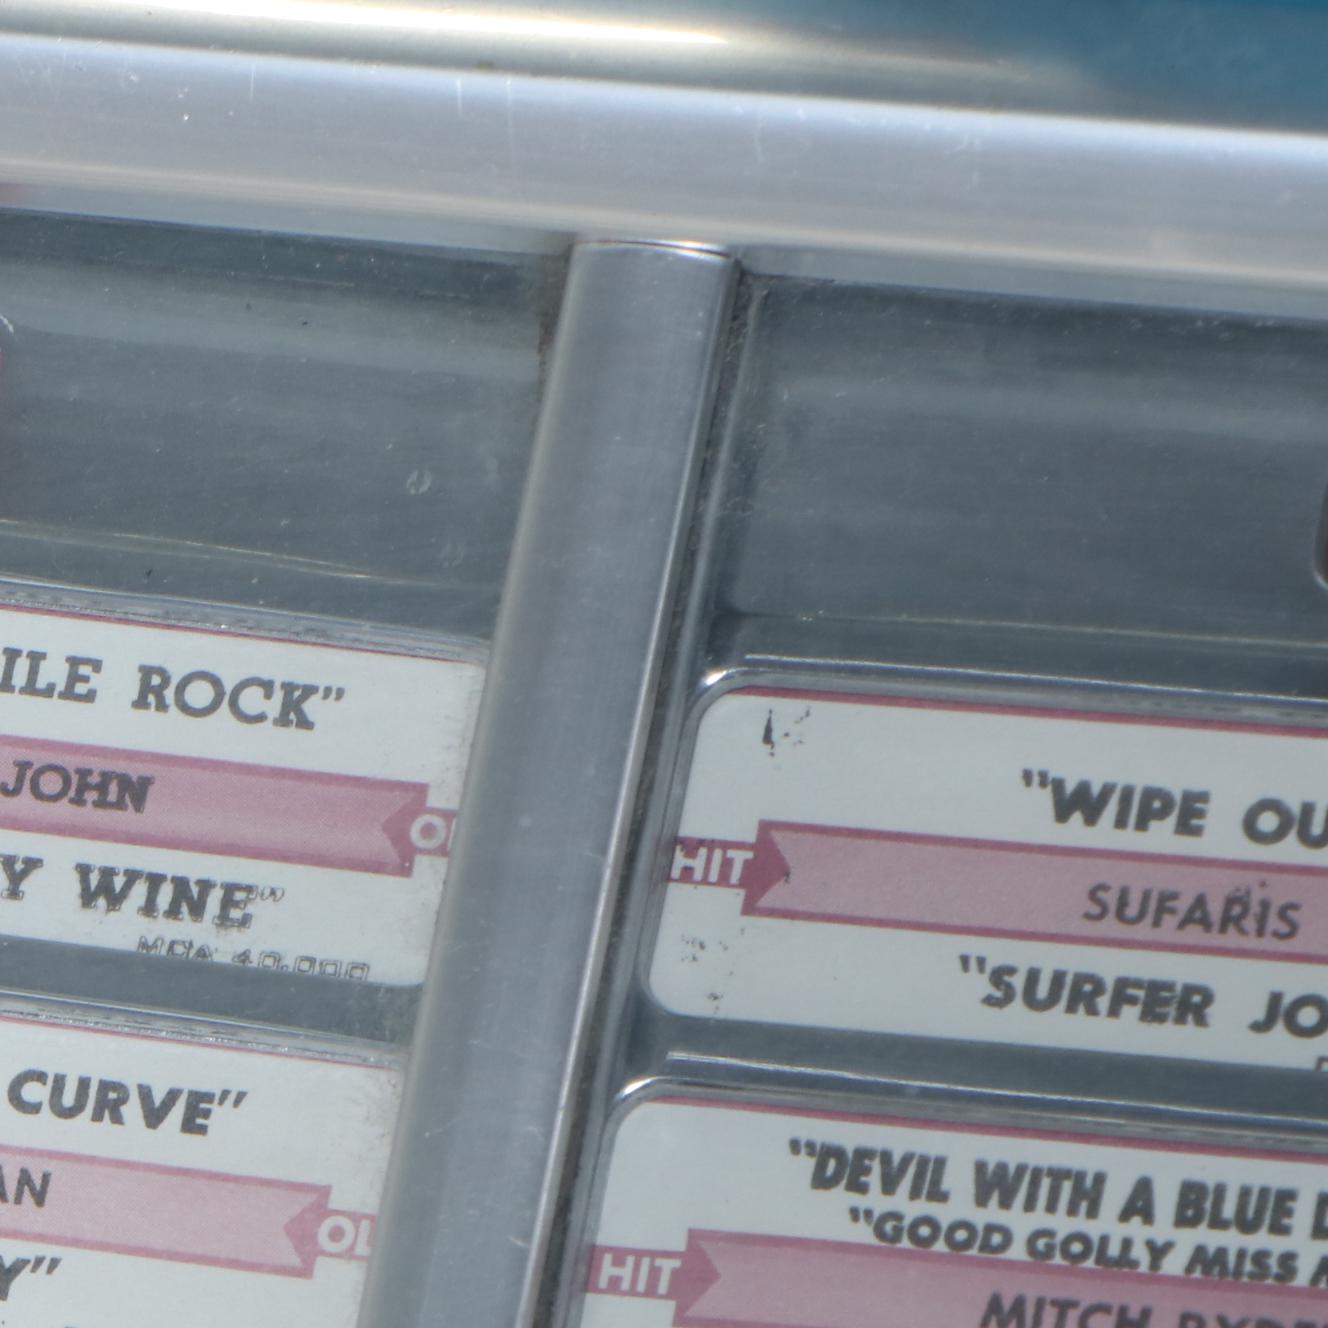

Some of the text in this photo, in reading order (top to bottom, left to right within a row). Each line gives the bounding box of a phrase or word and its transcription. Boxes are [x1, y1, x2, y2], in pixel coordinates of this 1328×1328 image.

[130, 663, 346, 732] ROCK"
[1021, 767, 1211, 838] "WIPE
[73, 861, 285, 931] WINE"
[1082, 882, 1301, 941] SUFARIS
[958, 953, 1215, 1029] "SURFER
[6, 1067, 249, 1137] CURVE"
[788, 1136, 951, 1204] "DEVIL
